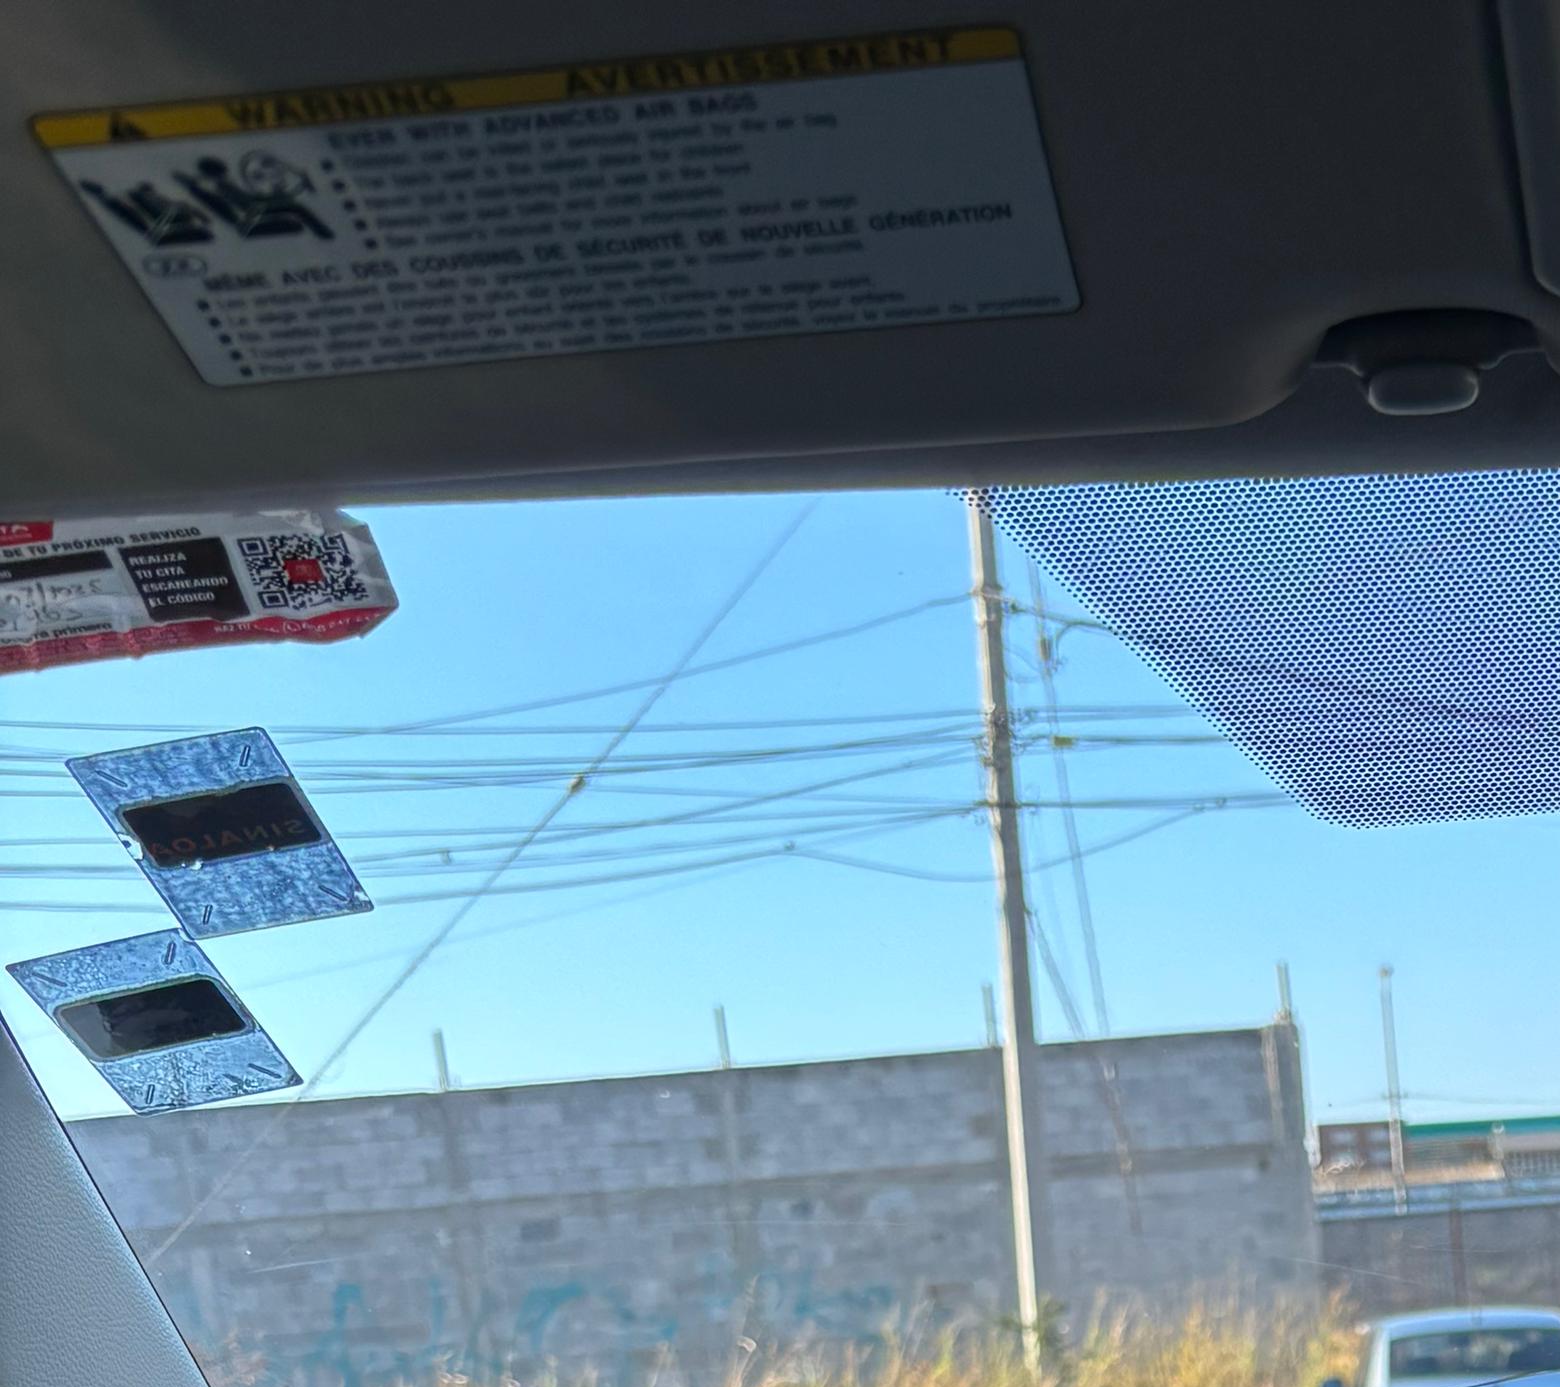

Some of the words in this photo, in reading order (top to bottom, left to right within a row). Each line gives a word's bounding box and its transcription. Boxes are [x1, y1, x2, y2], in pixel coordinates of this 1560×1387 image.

[231, 86, 454, 128] WARNING
[565, 36, 952, 99] AVERTISSEMENT
[486, 106, 621, 136] ADVANCED
[636, 99, 675, 120] AIR
[689, 92, 758, 117] BAGS
[282, 264, 342, 285] AVEC
[355, 257, 398, 281] DES
[535, 243, 566, 265] DE
[577, 223, 685, 256] SÉCURITÉ
[699, 227, 729, 246] DE
[742, 216, 858, 243] NOUVELLE
[869, 201, 1013, 232] GÉNÉRATION
[26, 545, 47, 557] TU
[129, 526, 202, 543] SERVICIO
[127, 552, 188, 567] REALIZA
[134, 568, 153, 580] TU
[156, 565, 187, 578] CITA
[142, 575, 230, 594] ESCANEANDO
[147, 596, 166, 609] EL
[167, 590, 217, 605] CÓDIGO
